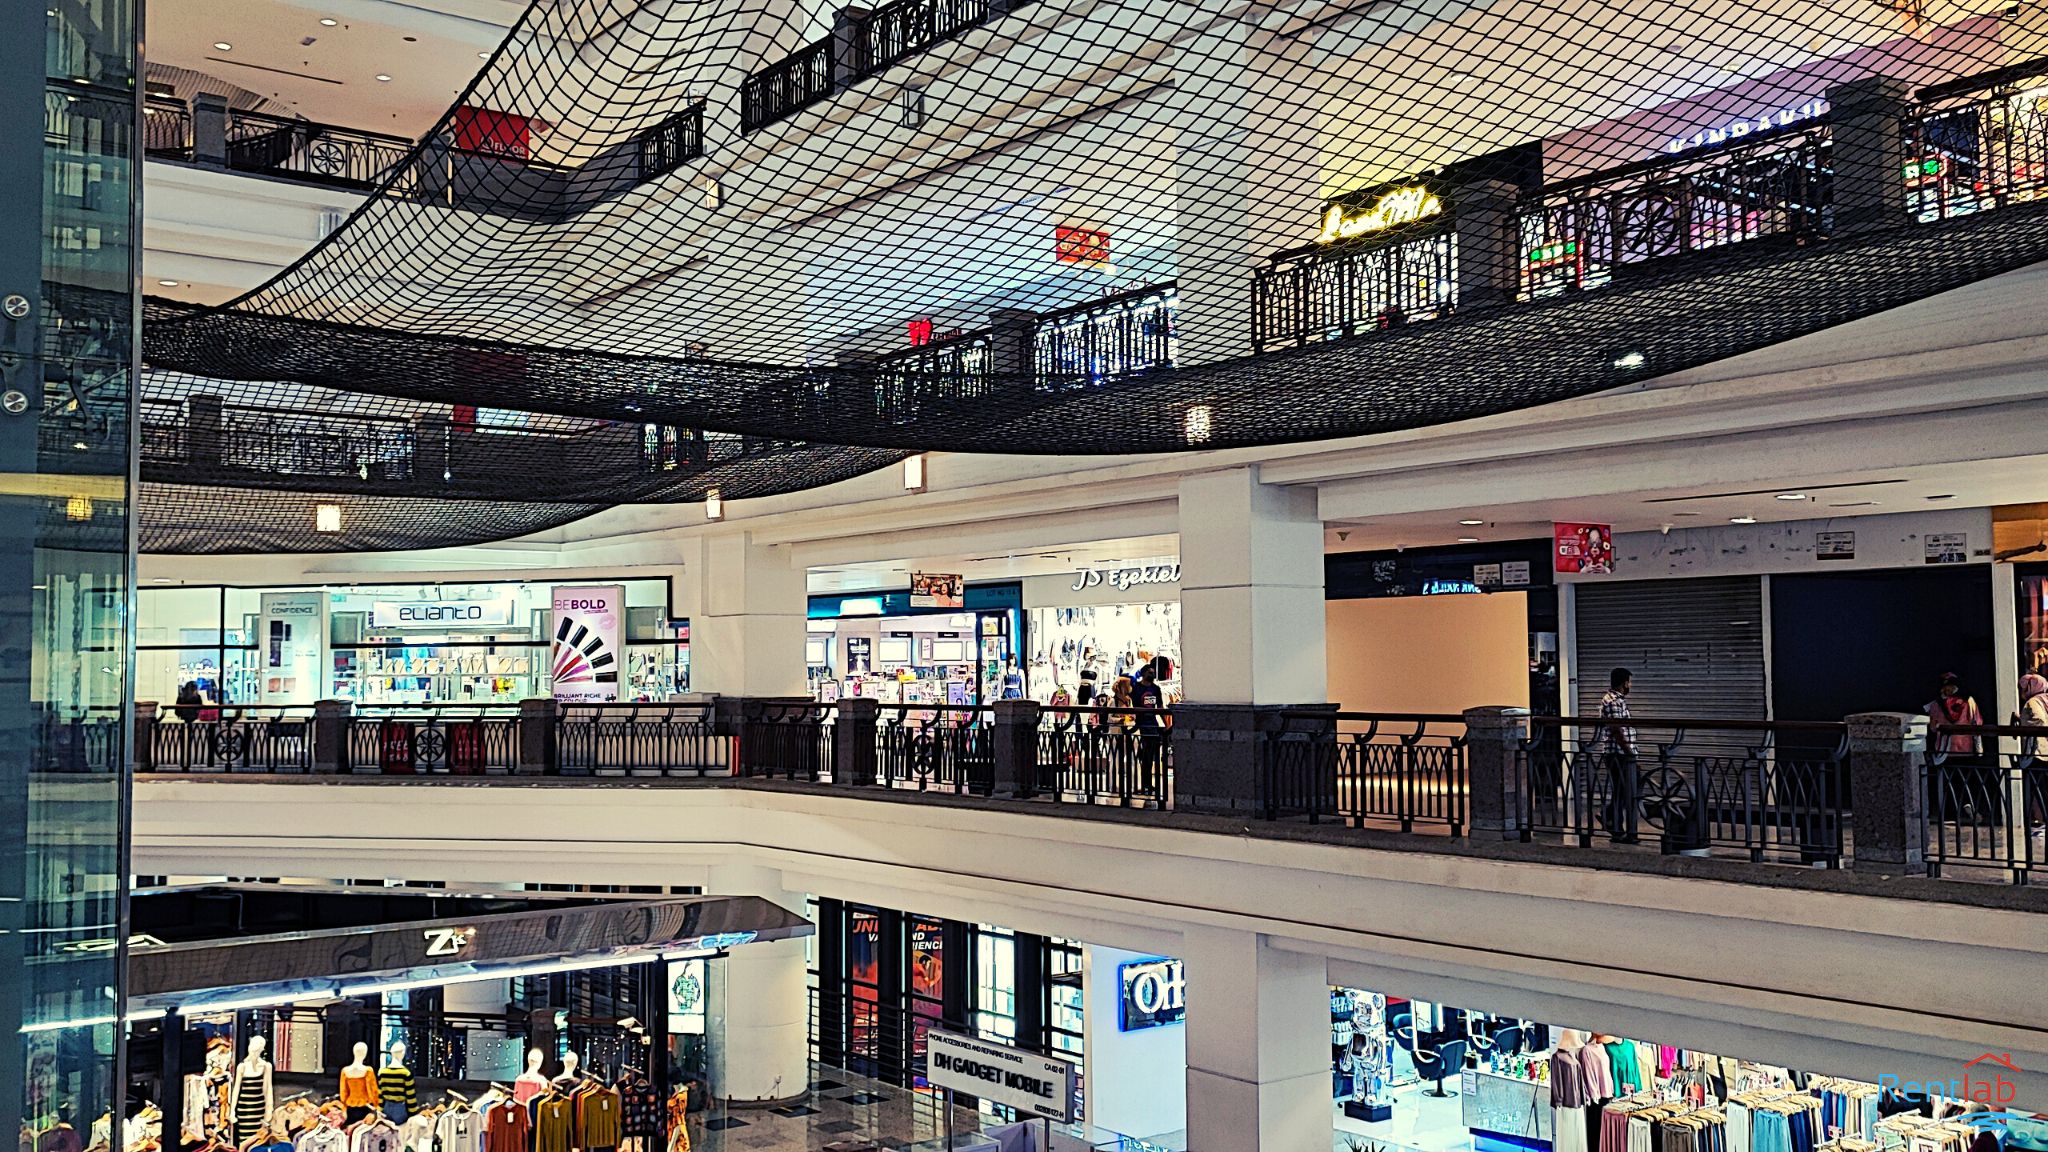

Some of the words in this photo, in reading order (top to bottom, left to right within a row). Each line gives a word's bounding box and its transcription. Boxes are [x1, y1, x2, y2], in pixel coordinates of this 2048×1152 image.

[1071, 569, 1103, 591] JS
[1107, 565, 1181, 592] Ezekiel
[943, 1036, 972, 1050] ACCESSORIES
[971, 1045, 981, 1053] AND
[980, 1046, 1005, 1059] REPAIRING
[1004, 1052, 1023, 1064] SERVICE
[934, 1052, 951, 1071] DH
[952, 1058, 1003, 1084] GADGET
[1005, 1071, 1053, 1098] MOBILE
